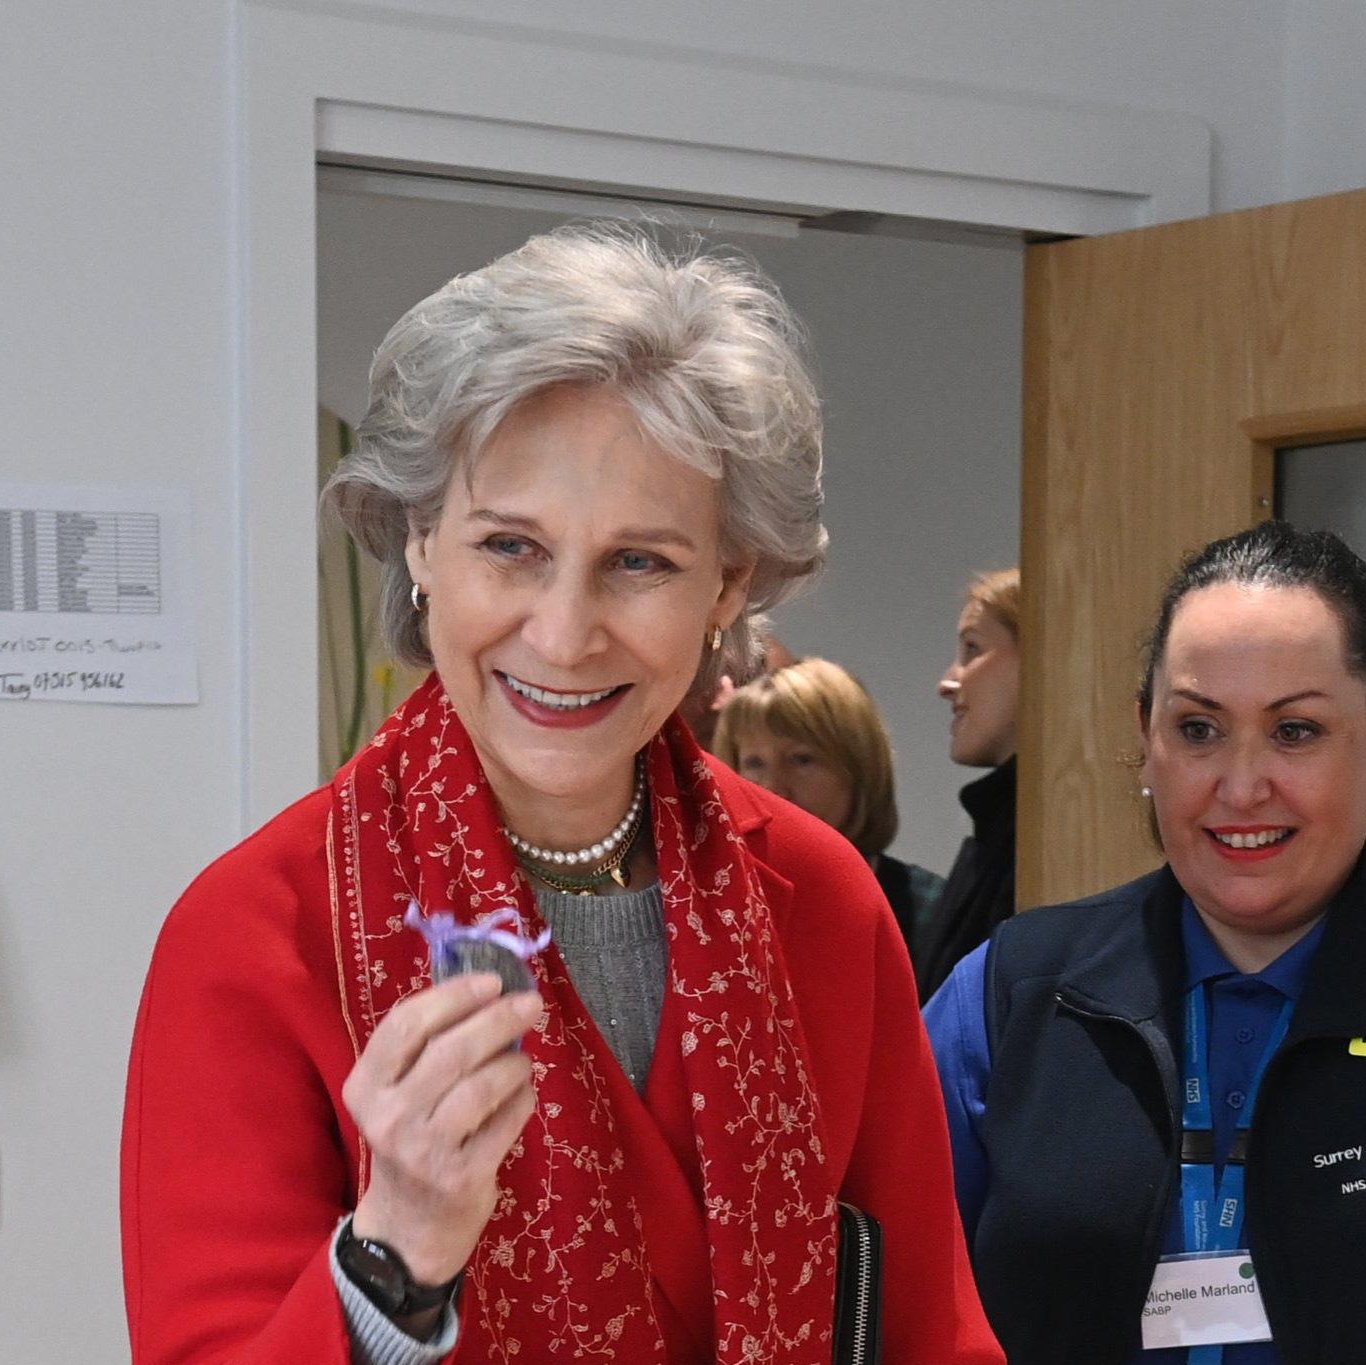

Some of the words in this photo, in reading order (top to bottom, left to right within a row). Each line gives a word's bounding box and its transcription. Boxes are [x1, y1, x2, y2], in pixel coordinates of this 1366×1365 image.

[1187, 1080, 1199, 1102] NHS
[1313, 1145, 1363, 1168] Surrey
[1341, 1179, 1366, 1195] NHS
[1221, 1200, 1236, 1226] NHS
[1144, 1285, 1198, 1305] Michelle
[1201, 1279, 1255, 1300] Marland
[1142, 1305, 1172, 1318] SABP
